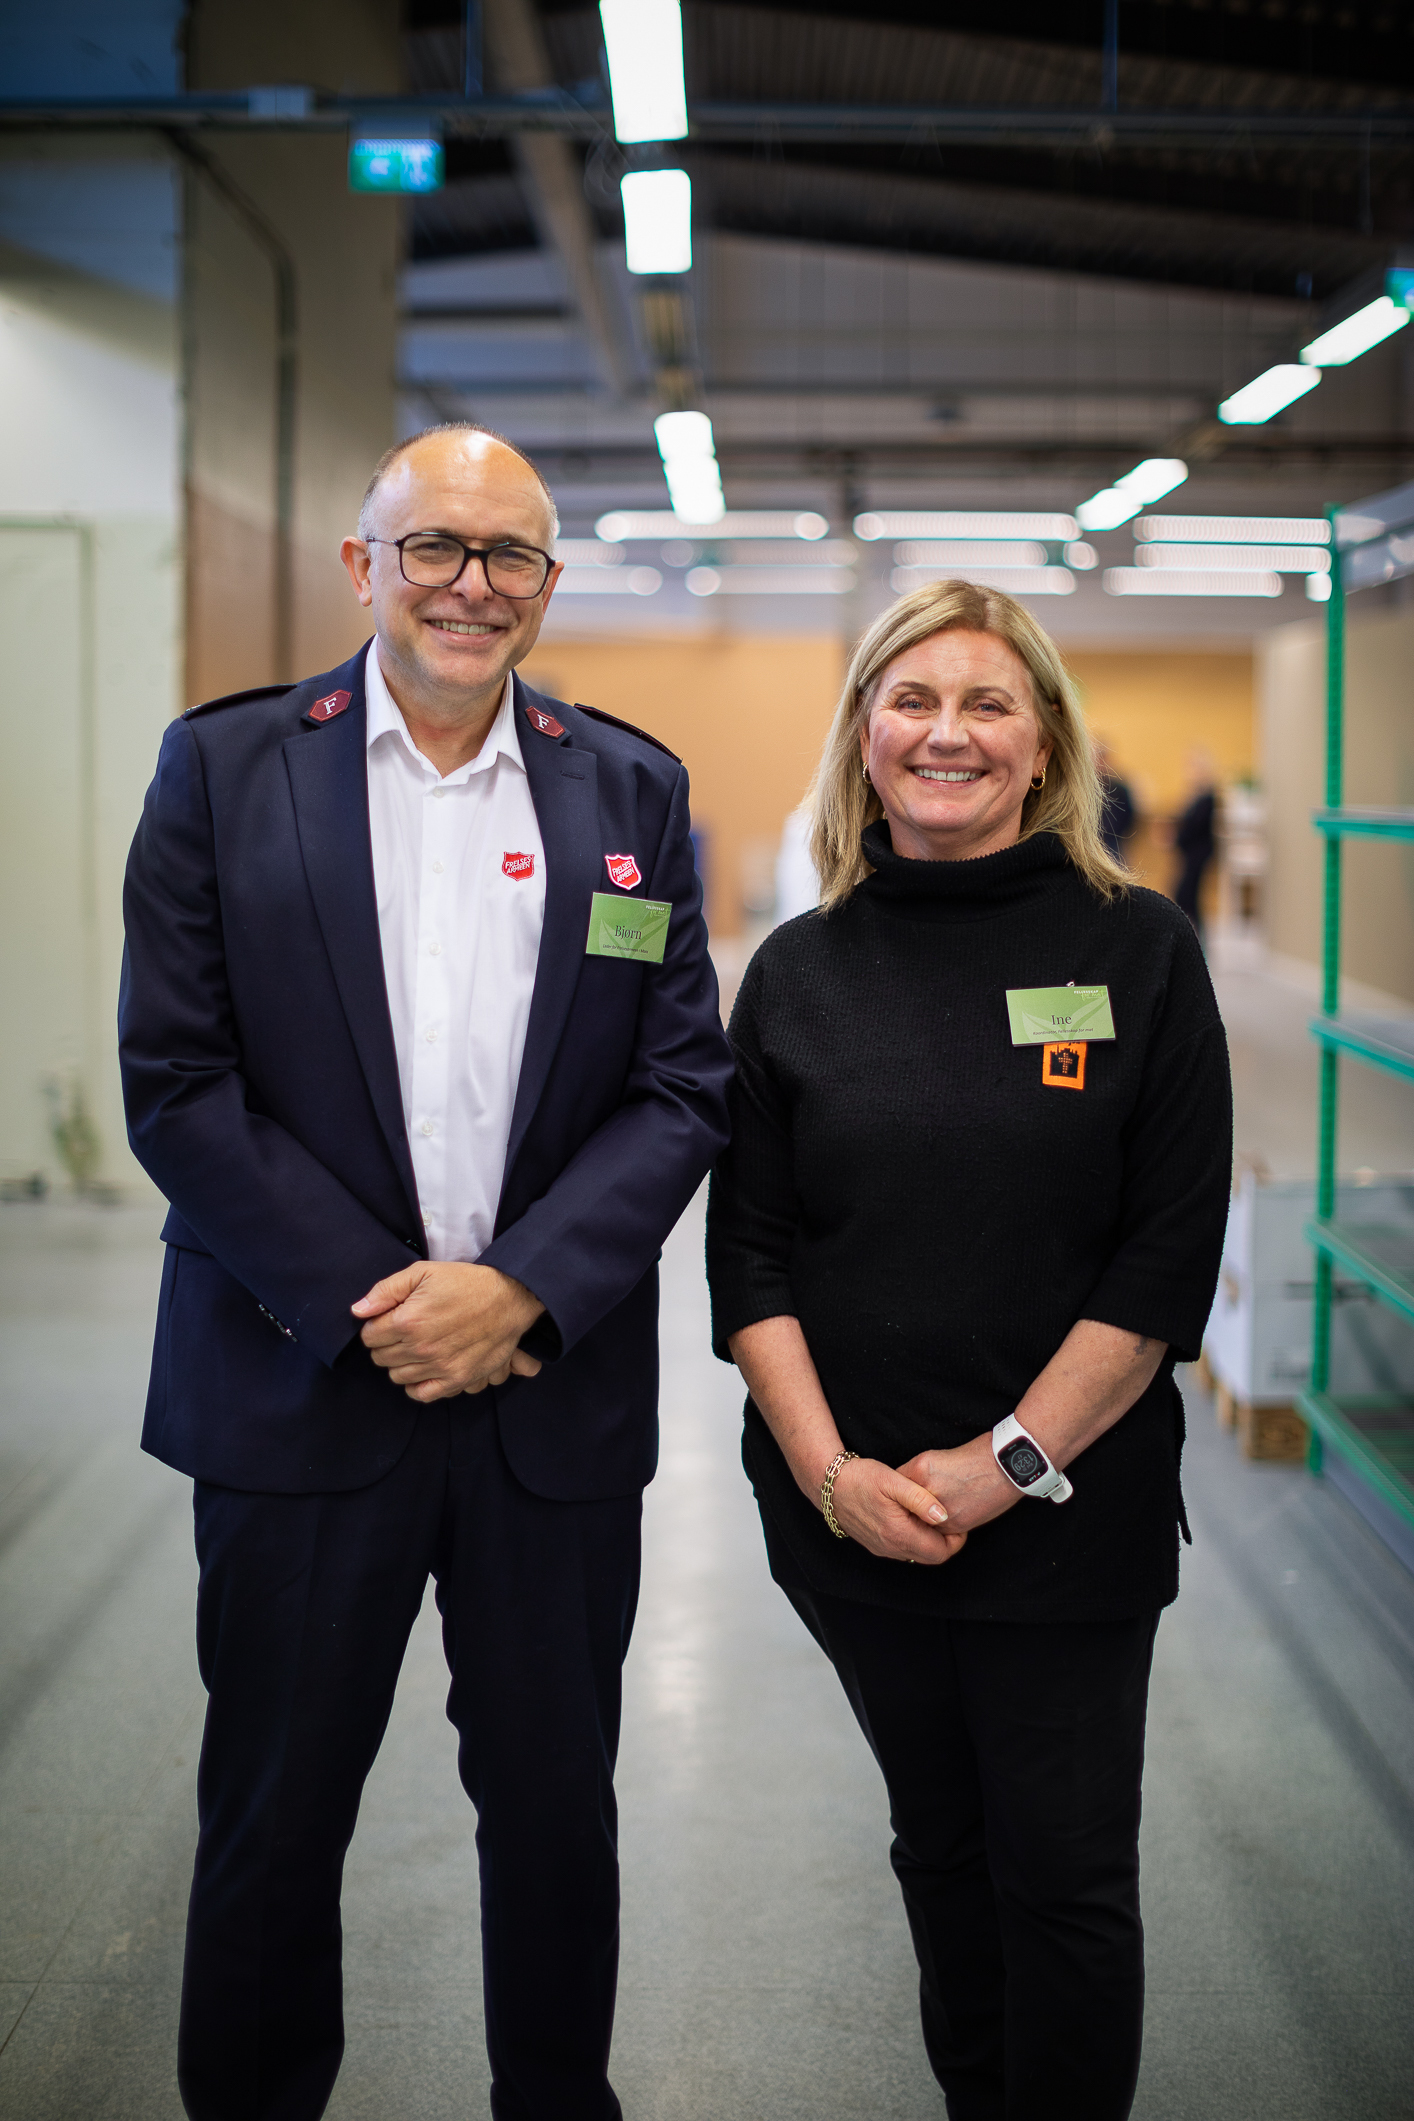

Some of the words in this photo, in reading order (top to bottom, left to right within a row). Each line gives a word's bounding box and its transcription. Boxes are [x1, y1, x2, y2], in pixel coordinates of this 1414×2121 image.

[324, 697, 337, 715] F
[537, 714, 549, 729] F
[615, 925, 642, 940] Bjørn
[1051, 1015, 1072, 1025] Ine
